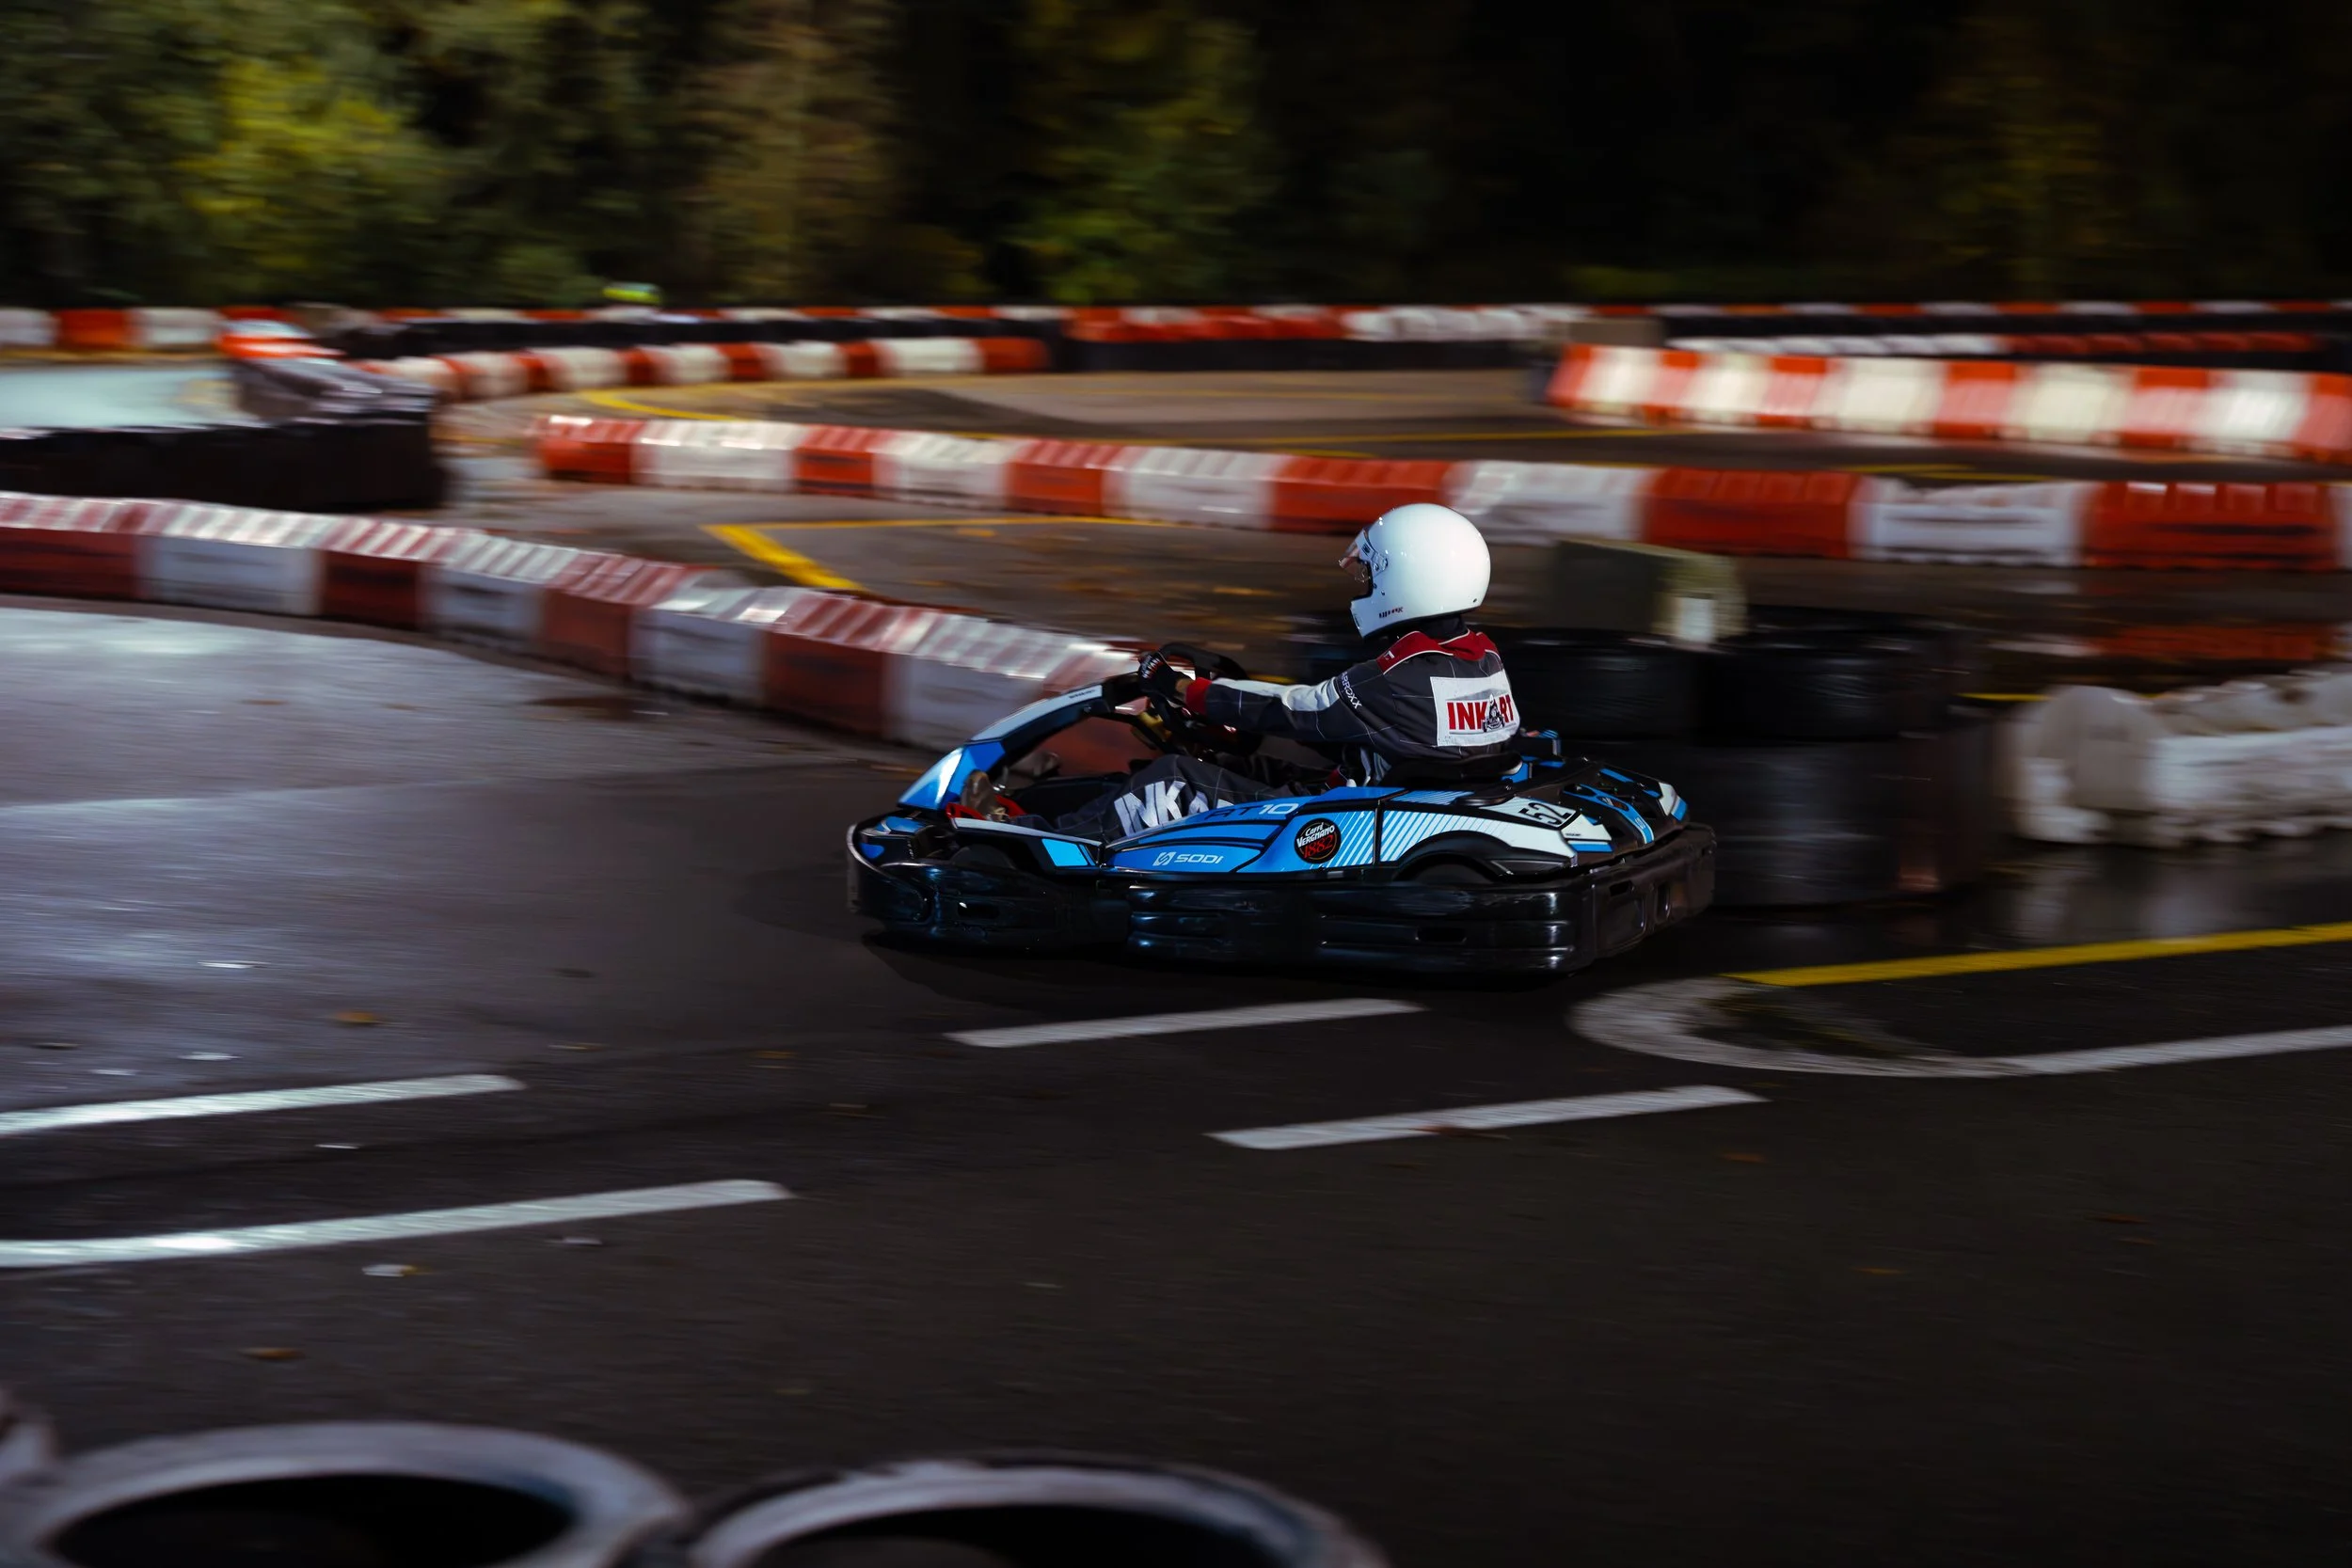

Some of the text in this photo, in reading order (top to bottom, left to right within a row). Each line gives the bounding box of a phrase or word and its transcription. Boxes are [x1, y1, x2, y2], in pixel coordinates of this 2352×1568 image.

[1518, 801, 1574, 825] 52
[1173, 853, 1225, 864] SODI
[1303, 834, 1334, 859] 1882
